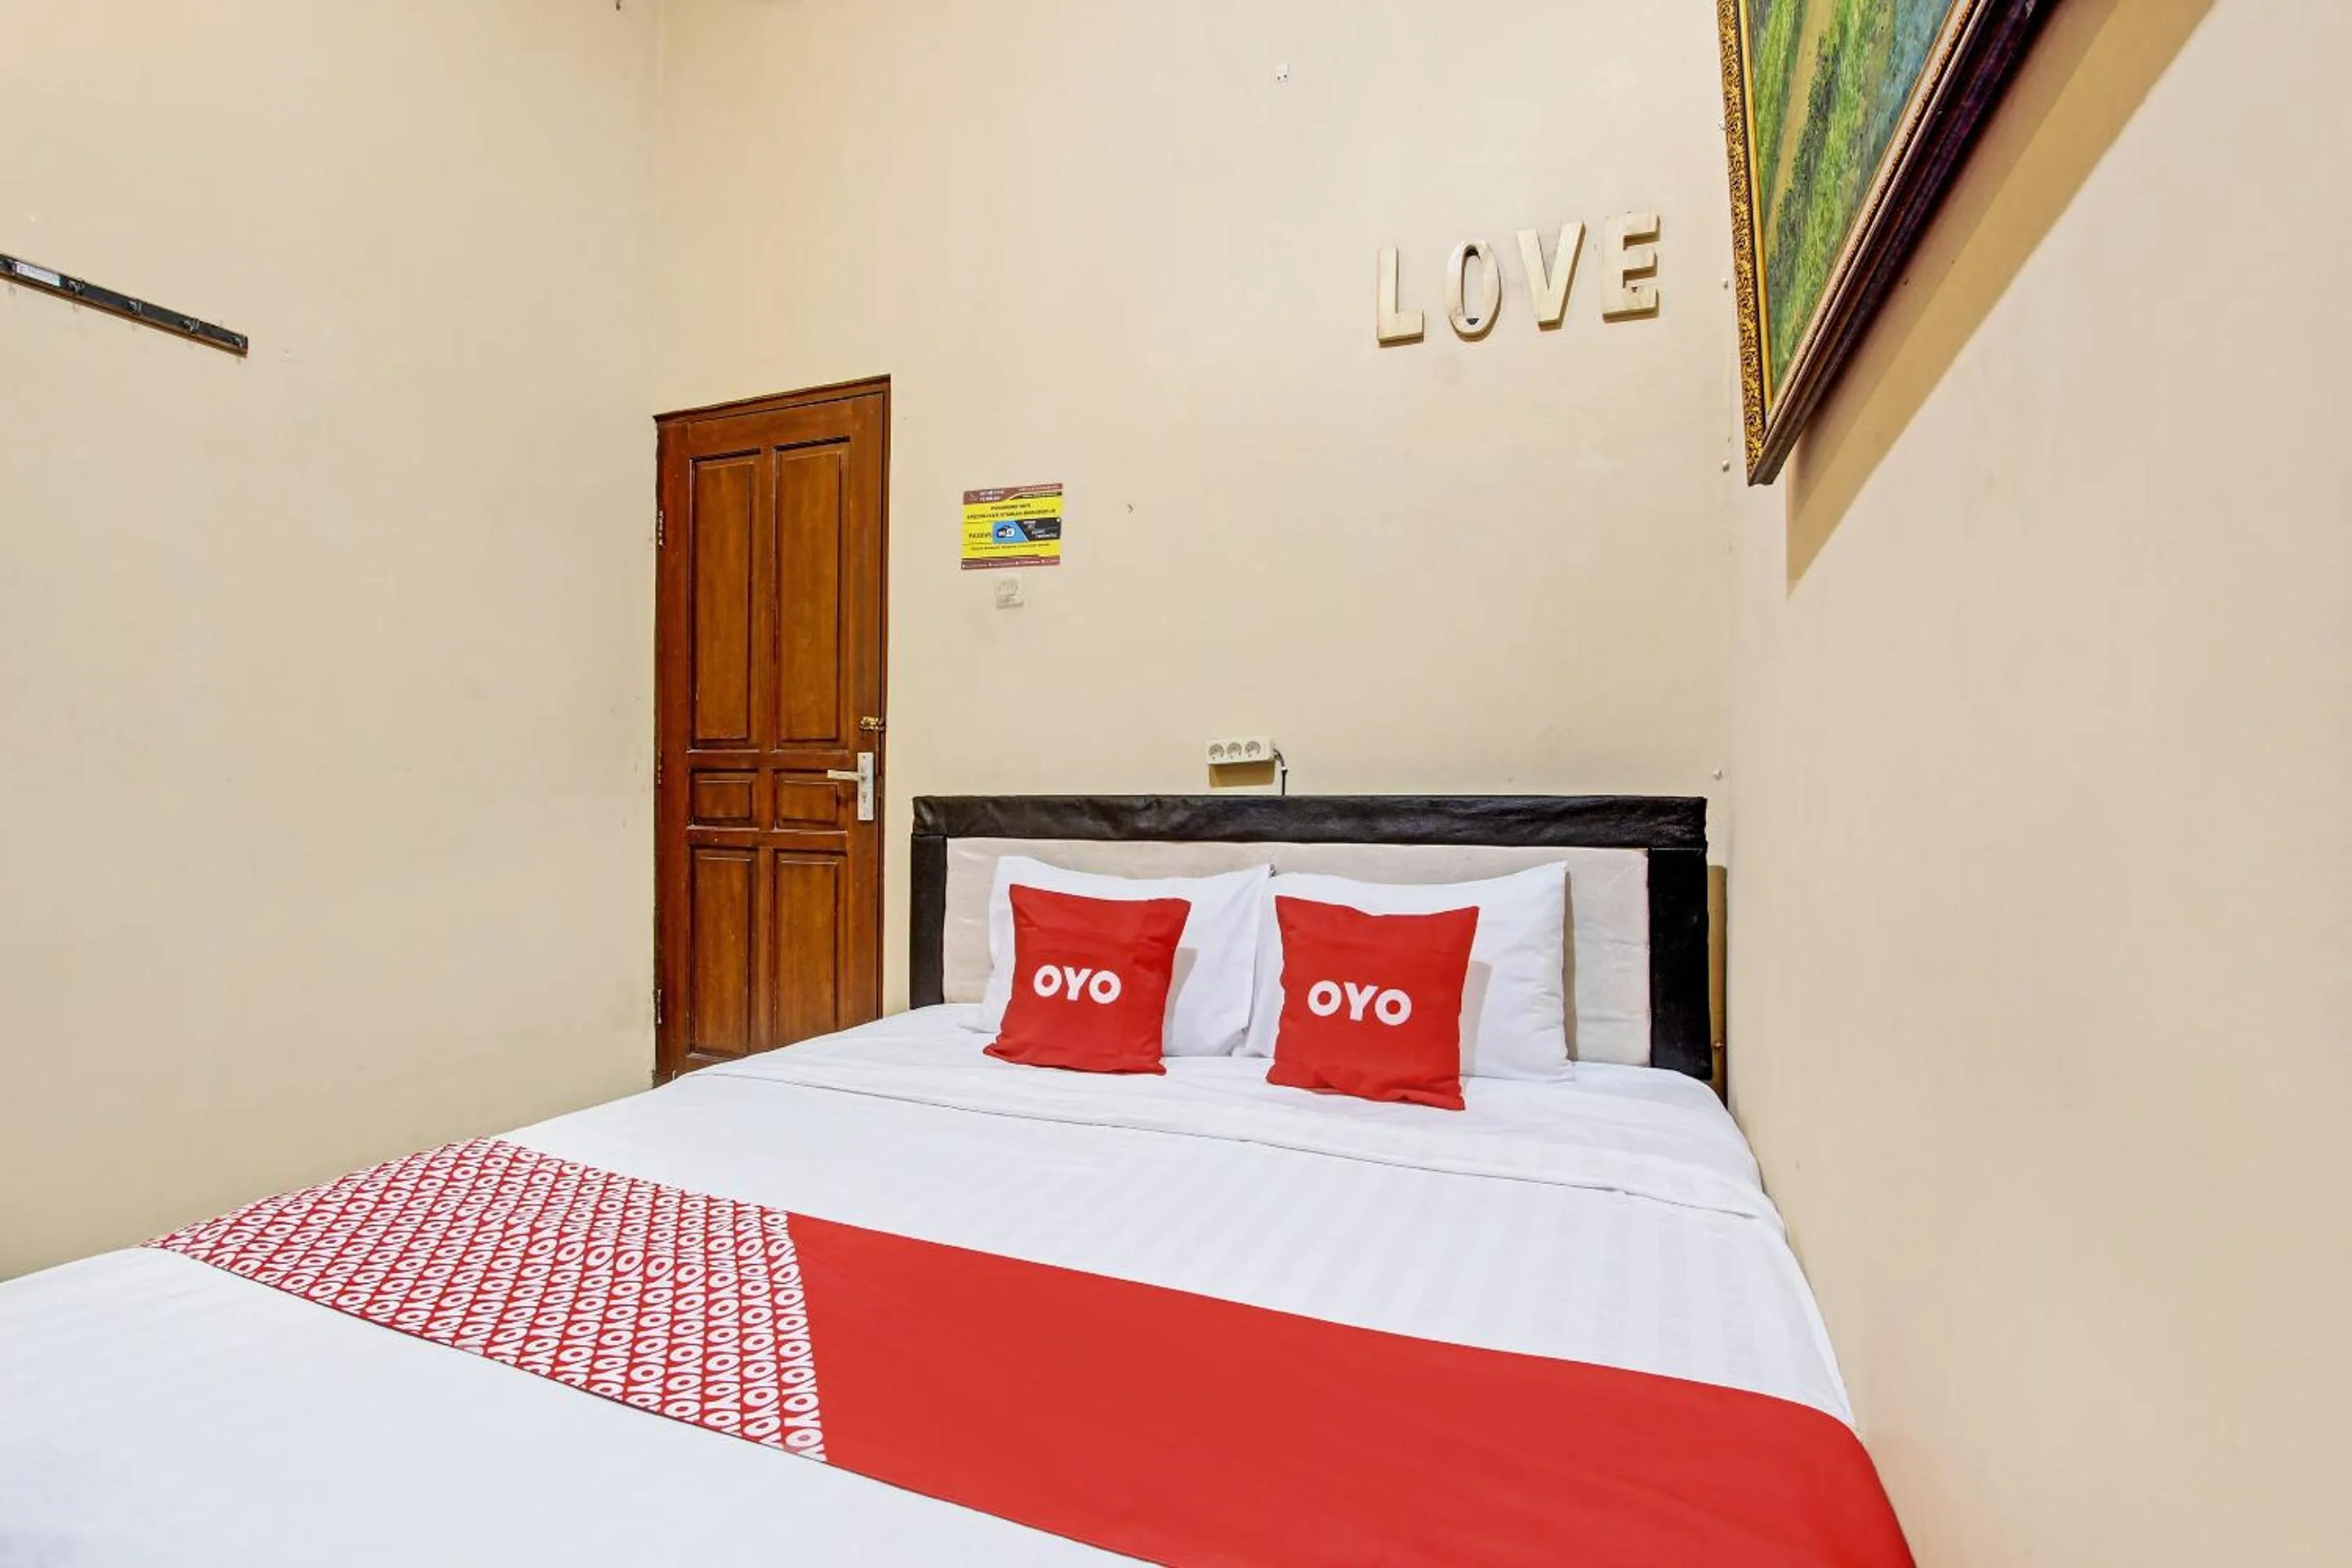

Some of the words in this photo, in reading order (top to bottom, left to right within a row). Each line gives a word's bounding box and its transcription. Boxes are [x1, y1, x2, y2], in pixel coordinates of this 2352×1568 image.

[1378, 211, 1660, 348] LOVE
[1033, 964, 1122, 1004] OYO
[1307, 980, 1412, 1027] OYO
